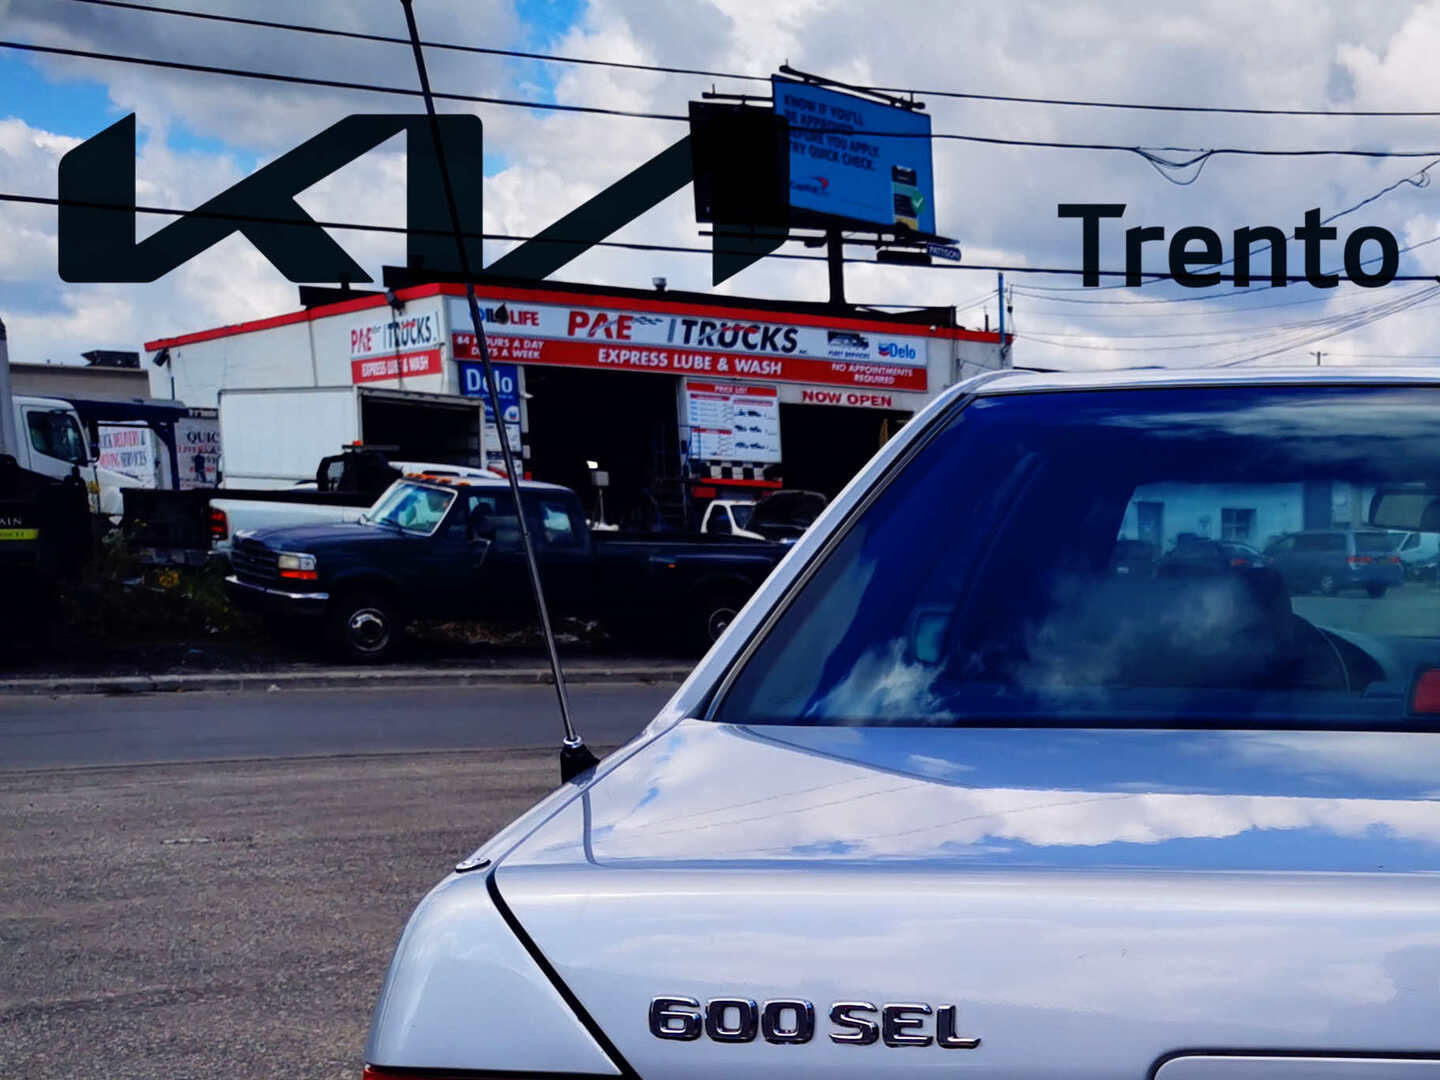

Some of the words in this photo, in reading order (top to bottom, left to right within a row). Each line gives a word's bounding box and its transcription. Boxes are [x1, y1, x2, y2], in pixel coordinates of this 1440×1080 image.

[510, 310, 540, 326] LIFE
[387, 316, 432, 348] TRUCKS
[567, 310, 633, 340] PAE
[681, 318, 799, 354] TRUCKS
[598, 348, 669, 368] EXPRESS
[673, 353, 713, 371] LUBE
[716, 357, 729, 372] &
[735, 358, 783, 376] WASH
[890, 343, 917, 360] Delo
[386, 359, 400, 376] LUB
[802, 390, 842, 404] NOW
[847, 393, 893, 407] OPEN
[648, 994, 816, 1046] 600
[827, 1000, 983, 1050] SEL
